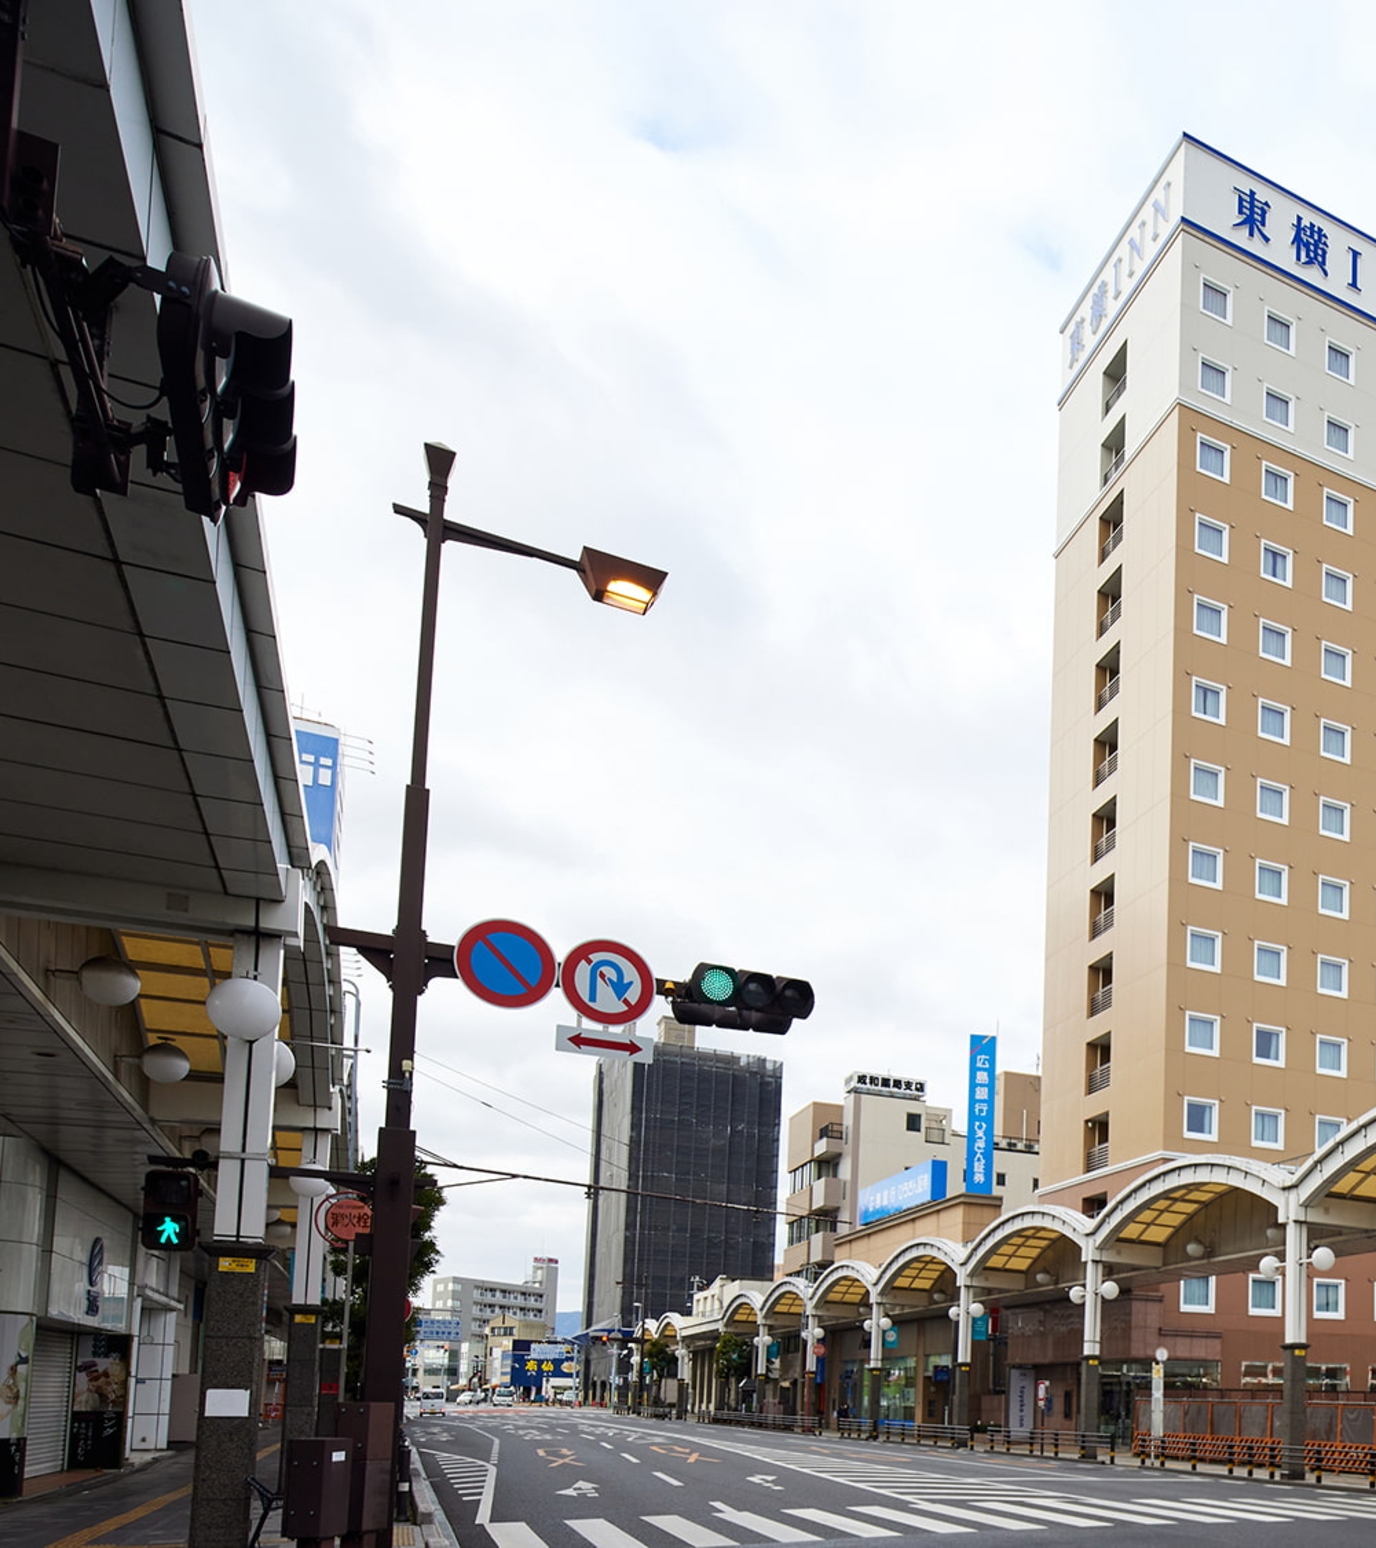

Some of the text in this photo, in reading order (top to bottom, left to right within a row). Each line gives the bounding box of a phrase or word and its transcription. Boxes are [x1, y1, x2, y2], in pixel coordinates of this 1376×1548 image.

[974, 1054, 990, 1117] 広島銀行
[330, 1212, 370, 1228] 消火栓
